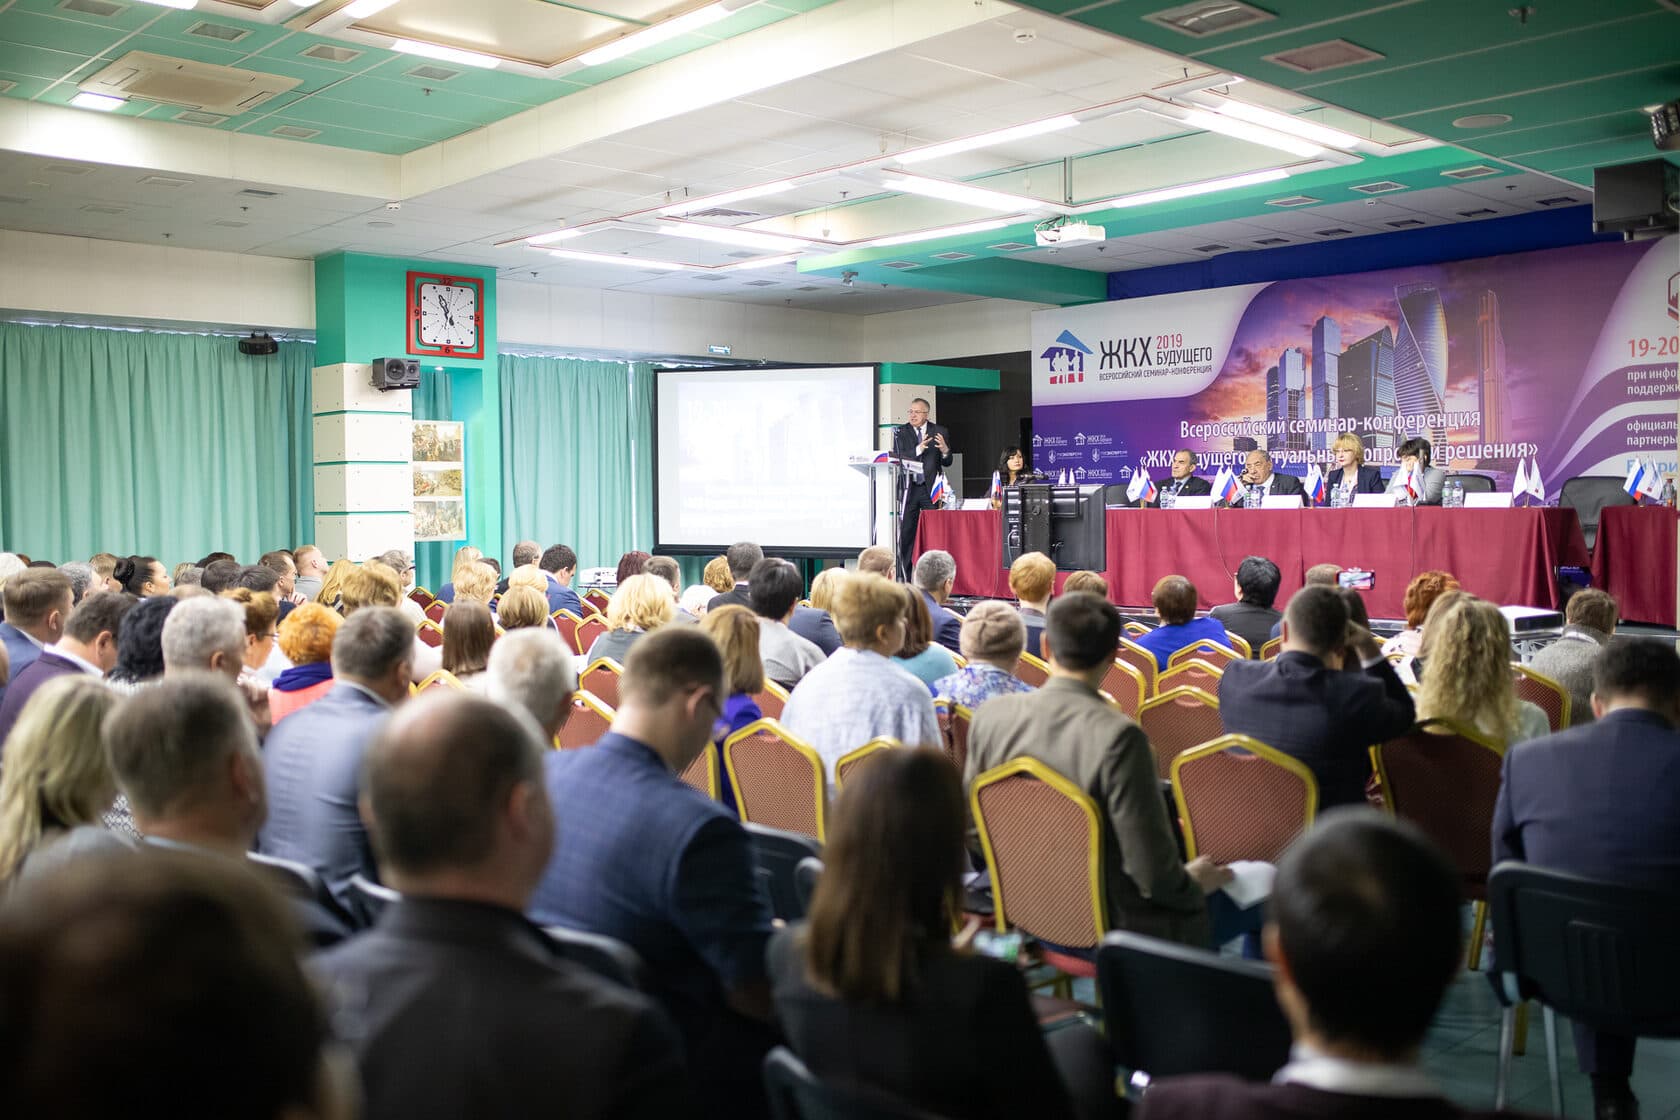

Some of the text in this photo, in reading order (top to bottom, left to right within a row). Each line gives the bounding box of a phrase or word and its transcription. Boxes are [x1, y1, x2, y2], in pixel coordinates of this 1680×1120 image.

[1099, 333, 1183, 370] ЖКХ 2019
[1156, 346, 1213, 366] БУДУЩЕГО
[1099, 365, 1213, 381] ВСЕРОССИЙСКИЙ СЕМИНАР-КОНФЕРЕНЦИЯ
[1627, 371, 1647, 382] при
[1180, 410, 1481, 442] Всероссийский семинар-конференция
[1445, 442, 1538, 465] решения»
